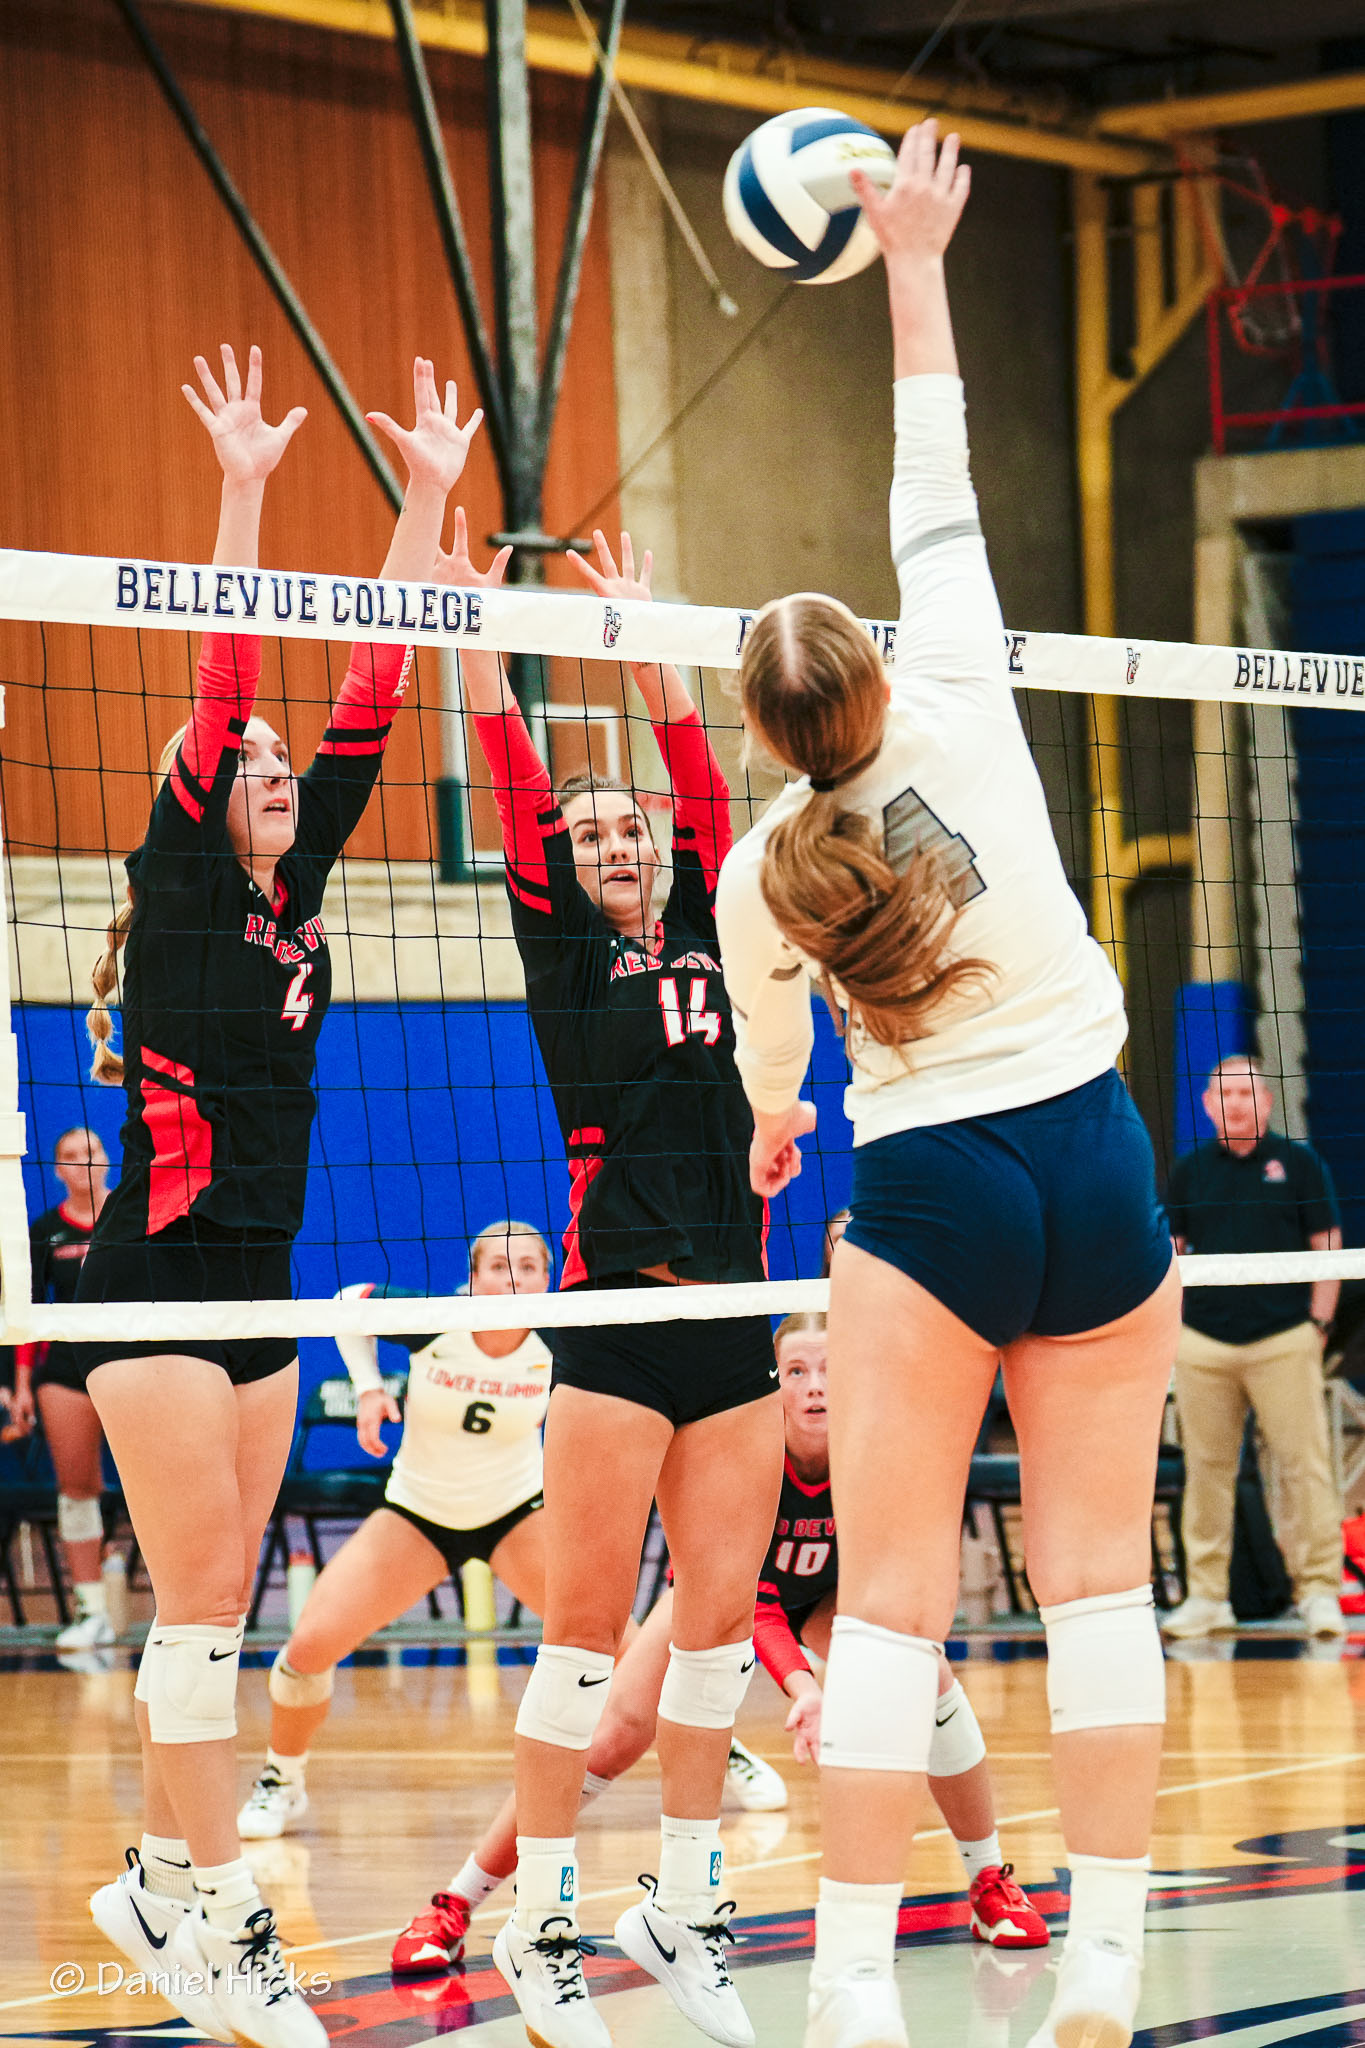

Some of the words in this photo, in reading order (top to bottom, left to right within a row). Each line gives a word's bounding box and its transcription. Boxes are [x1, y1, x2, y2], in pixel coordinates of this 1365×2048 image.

[115, 563, 318, 624] BELLEVUE
[331, 580, 483, 635] COLLEGE
[1233, 651, 1365, 698] BELLEVUE
[280, 962, 314, 1032] 4
[658, 977, 722, 1048] 14
[462, 1401, 496, 1434] 6
[775, 1541, 831, 1576] 10
